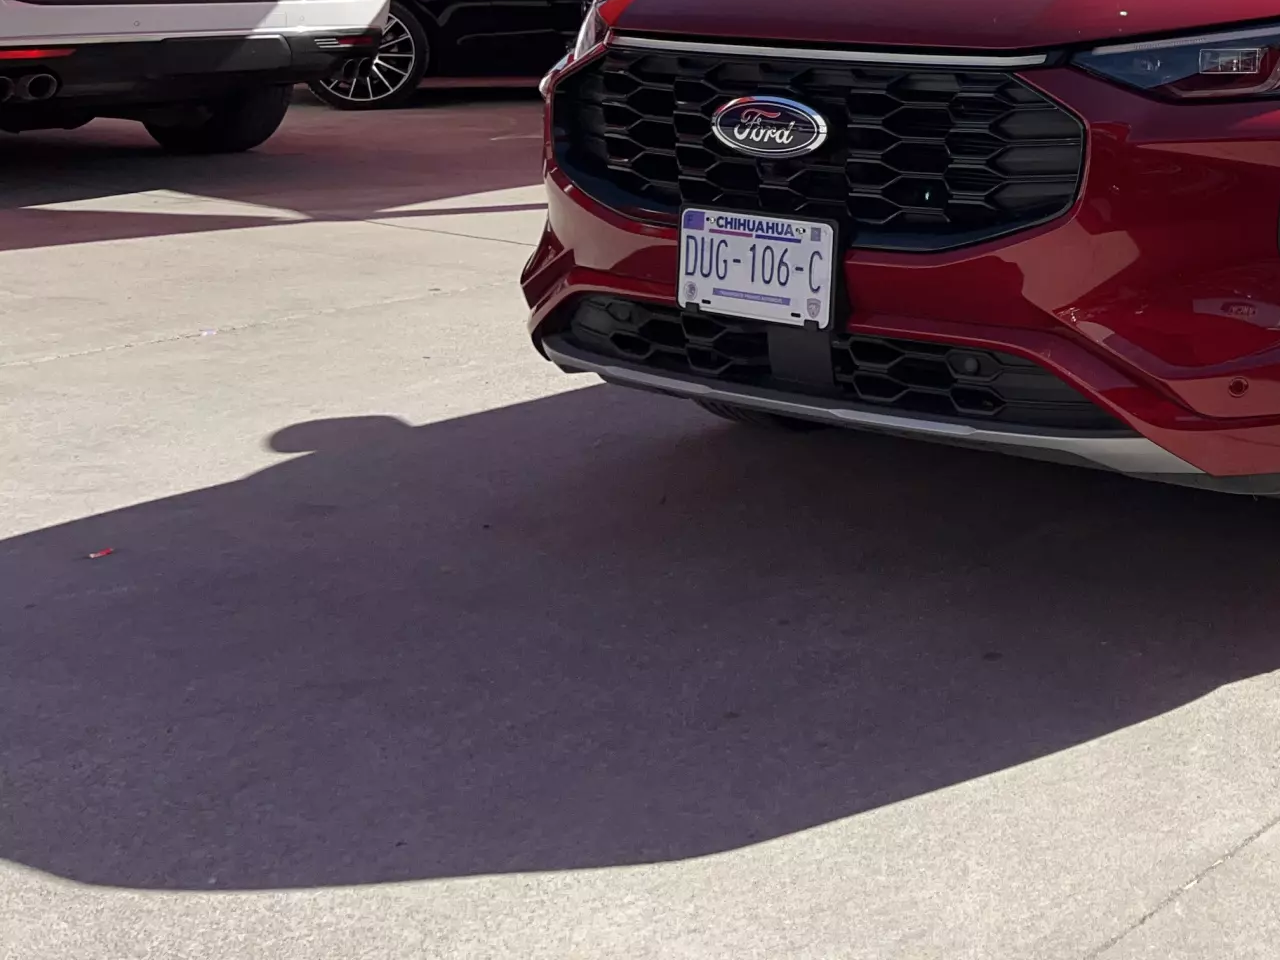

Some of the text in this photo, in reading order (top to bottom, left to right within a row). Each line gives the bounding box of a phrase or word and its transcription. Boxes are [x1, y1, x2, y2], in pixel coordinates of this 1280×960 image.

[733, 108, 795, 145] Ford
[716, 216, 795, 237] CHIHUAHUA
[685, 235, 823, 294] DUG-106-C
